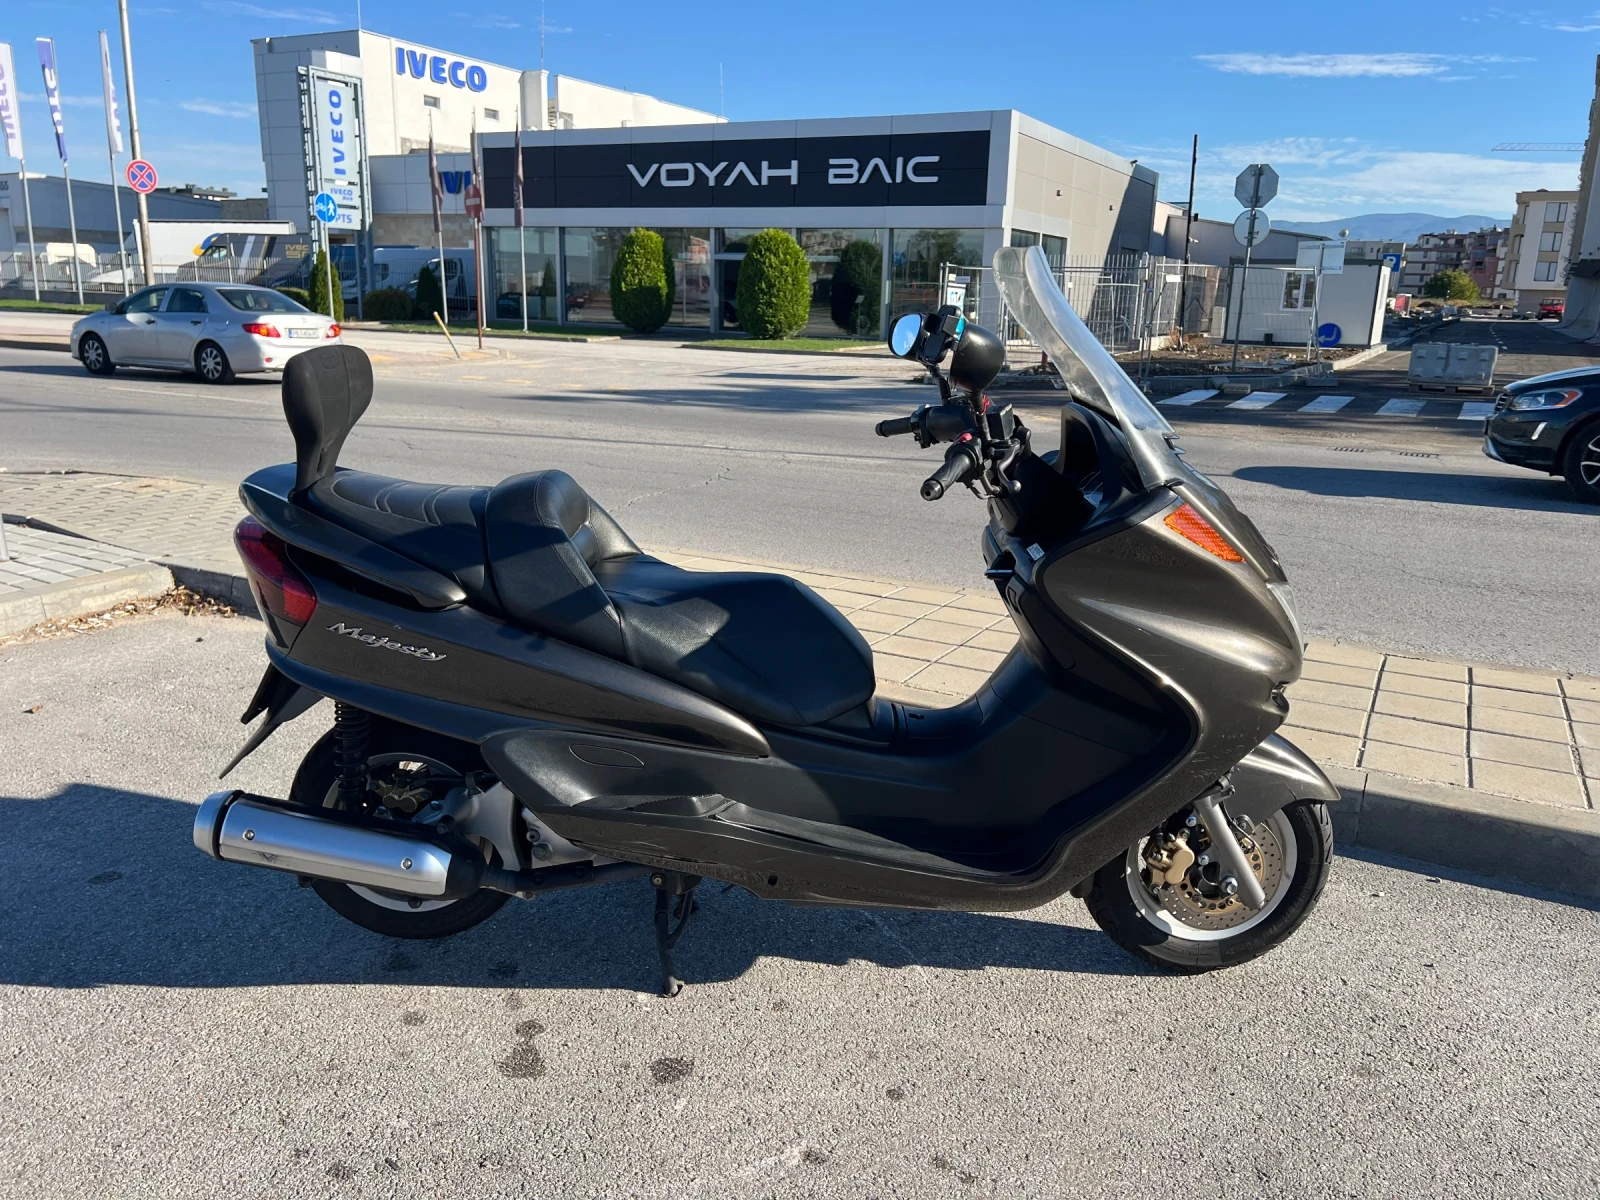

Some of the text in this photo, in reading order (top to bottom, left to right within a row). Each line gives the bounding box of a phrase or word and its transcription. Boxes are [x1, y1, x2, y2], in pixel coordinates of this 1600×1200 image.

[395, 47, 487, 92] IVECO
[328, 89, 347, 176] IVECO
[626, 155, 941, 188] VOYAH BAIC
[330, 187, 353, 197] IVECO
[326, 622, 447, 661] Majesty
